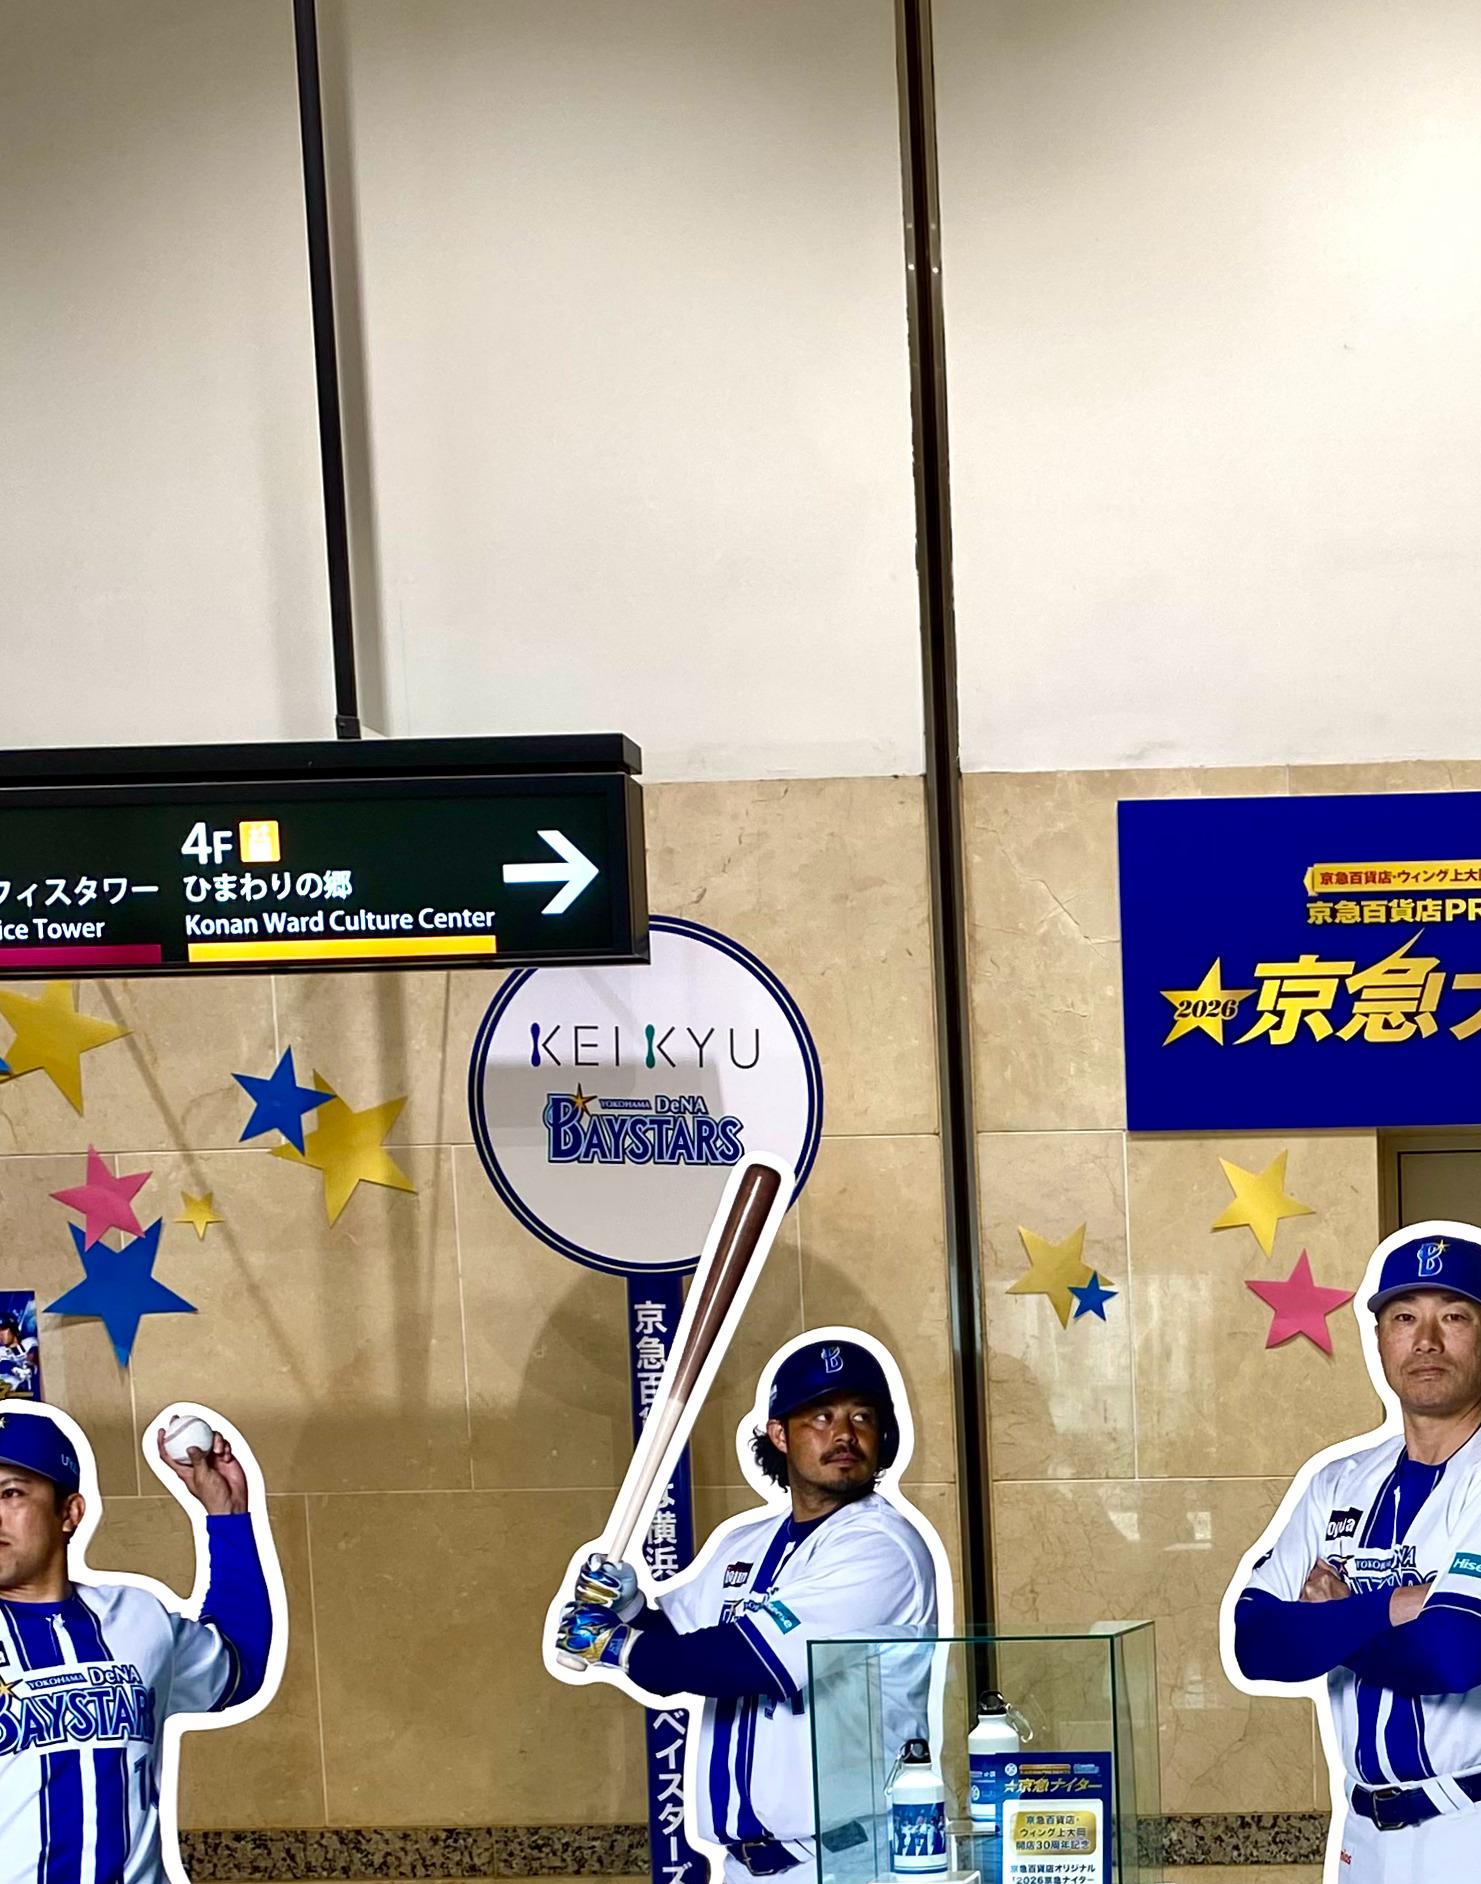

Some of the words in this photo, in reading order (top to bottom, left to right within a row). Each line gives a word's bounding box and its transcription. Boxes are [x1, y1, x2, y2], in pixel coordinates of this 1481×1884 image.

[181, 822, 232, 864] 4F
[184, 870, 352, 902] ひまわりの郷
[34, 917, 105, 939] Tower
[186, 912, 257, 935] Konan
[263, 911, 323, 934] Ward
[329, 909, 414, 932] Culture
[418, 906, 495, 929] Center
[1177, 998, 1238, 1021] 2026
[655, 1095, 709, 1114] DeNA
[544, 1092, 745, 1166] BAYSTARS
[88, 1665, 143, 1686] DeNA
